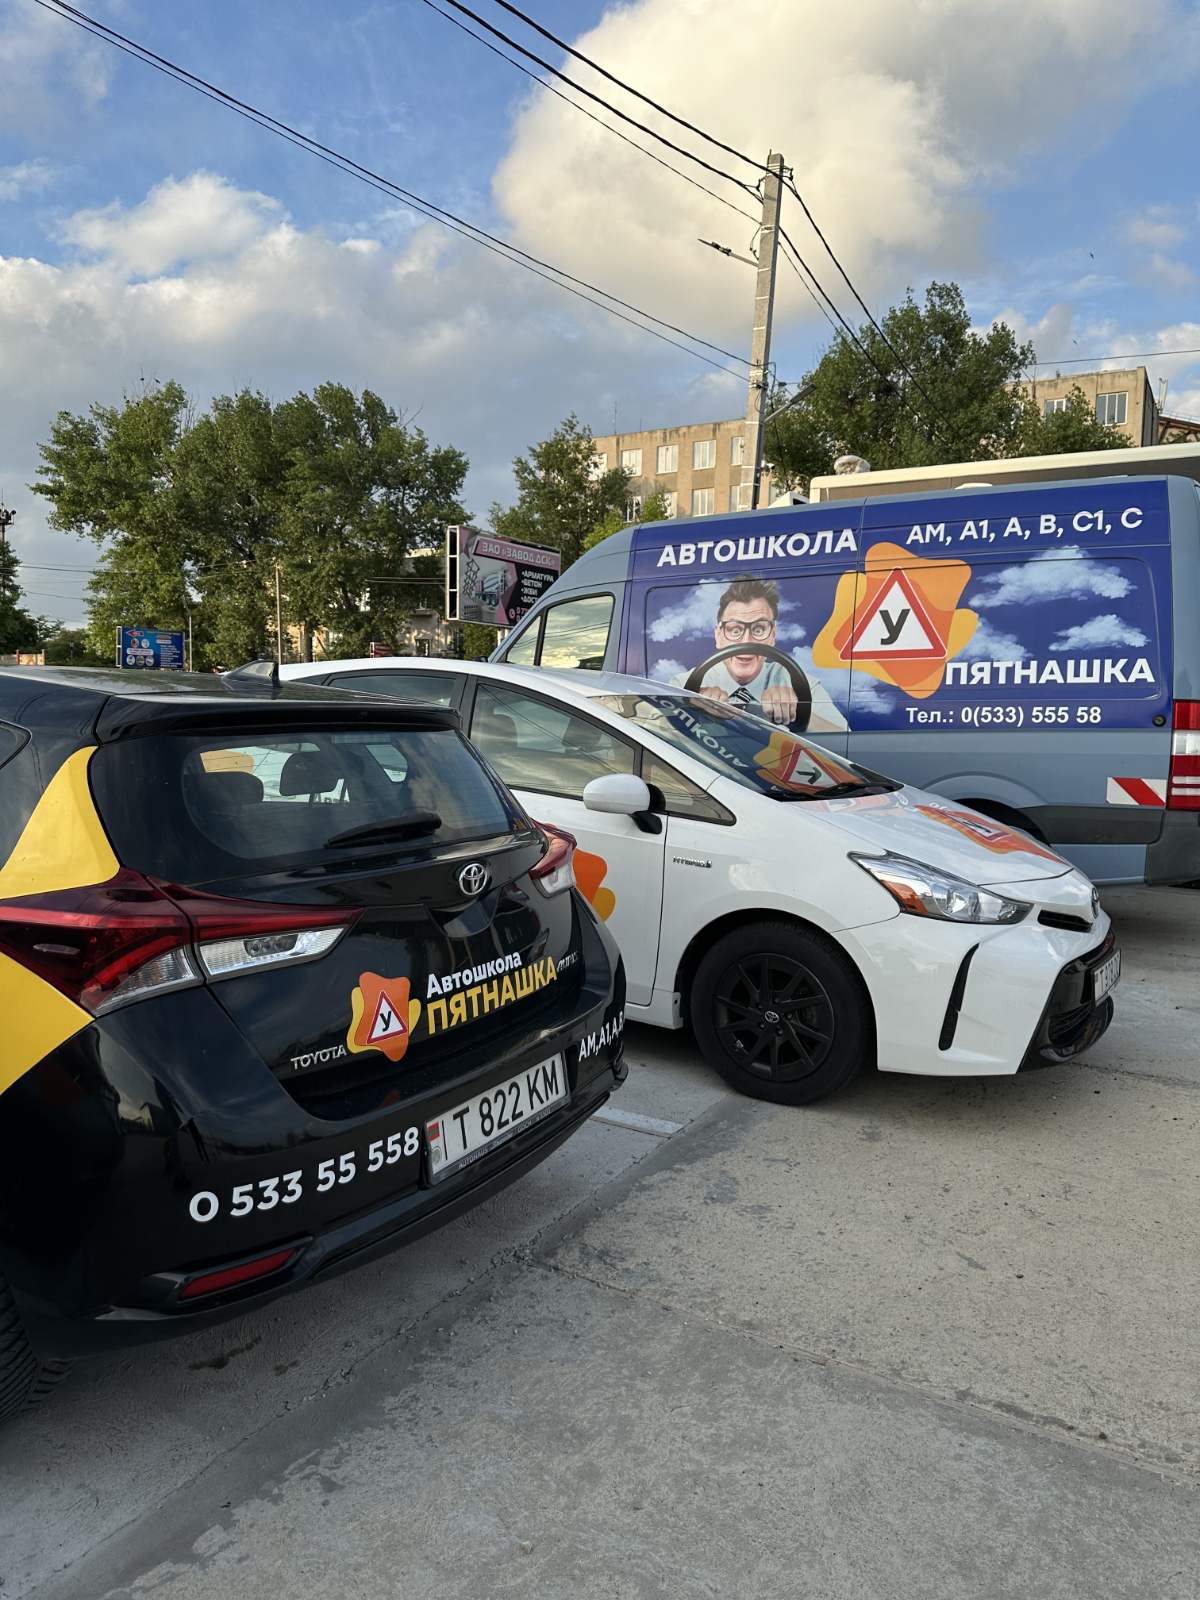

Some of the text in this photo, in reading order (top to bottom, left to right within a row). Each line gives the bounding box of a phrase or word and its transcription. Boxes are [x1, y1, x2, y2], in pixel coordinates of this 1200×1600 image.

[482, 542, 500, 553] ЗАО
[656, 528, 858, 568] АВТОШКОЛА
[959, 519, 995, 543] A1,
[879, 608, 911, 645] У
[945, 658, 1155, 685] ПЯТНАШКА
[906, 706, 1101, 727] Тел.: 0(533) 555 58
[427, 951, 522, 999] Автошкола
[427, 956, 558, 1035] ПЯТНАШКА
[290, 1044, 348, 1070] TOYOTA
[453, 1106, 470, 1150] T
[479, 1081, 524, 1137] 822
[526, 1059, 560, 1110] KM
[230, 1169, 303, 1216] 533
[316, 1151, 356, 1192] 55
[367, 1126, 419, 1172] 558
